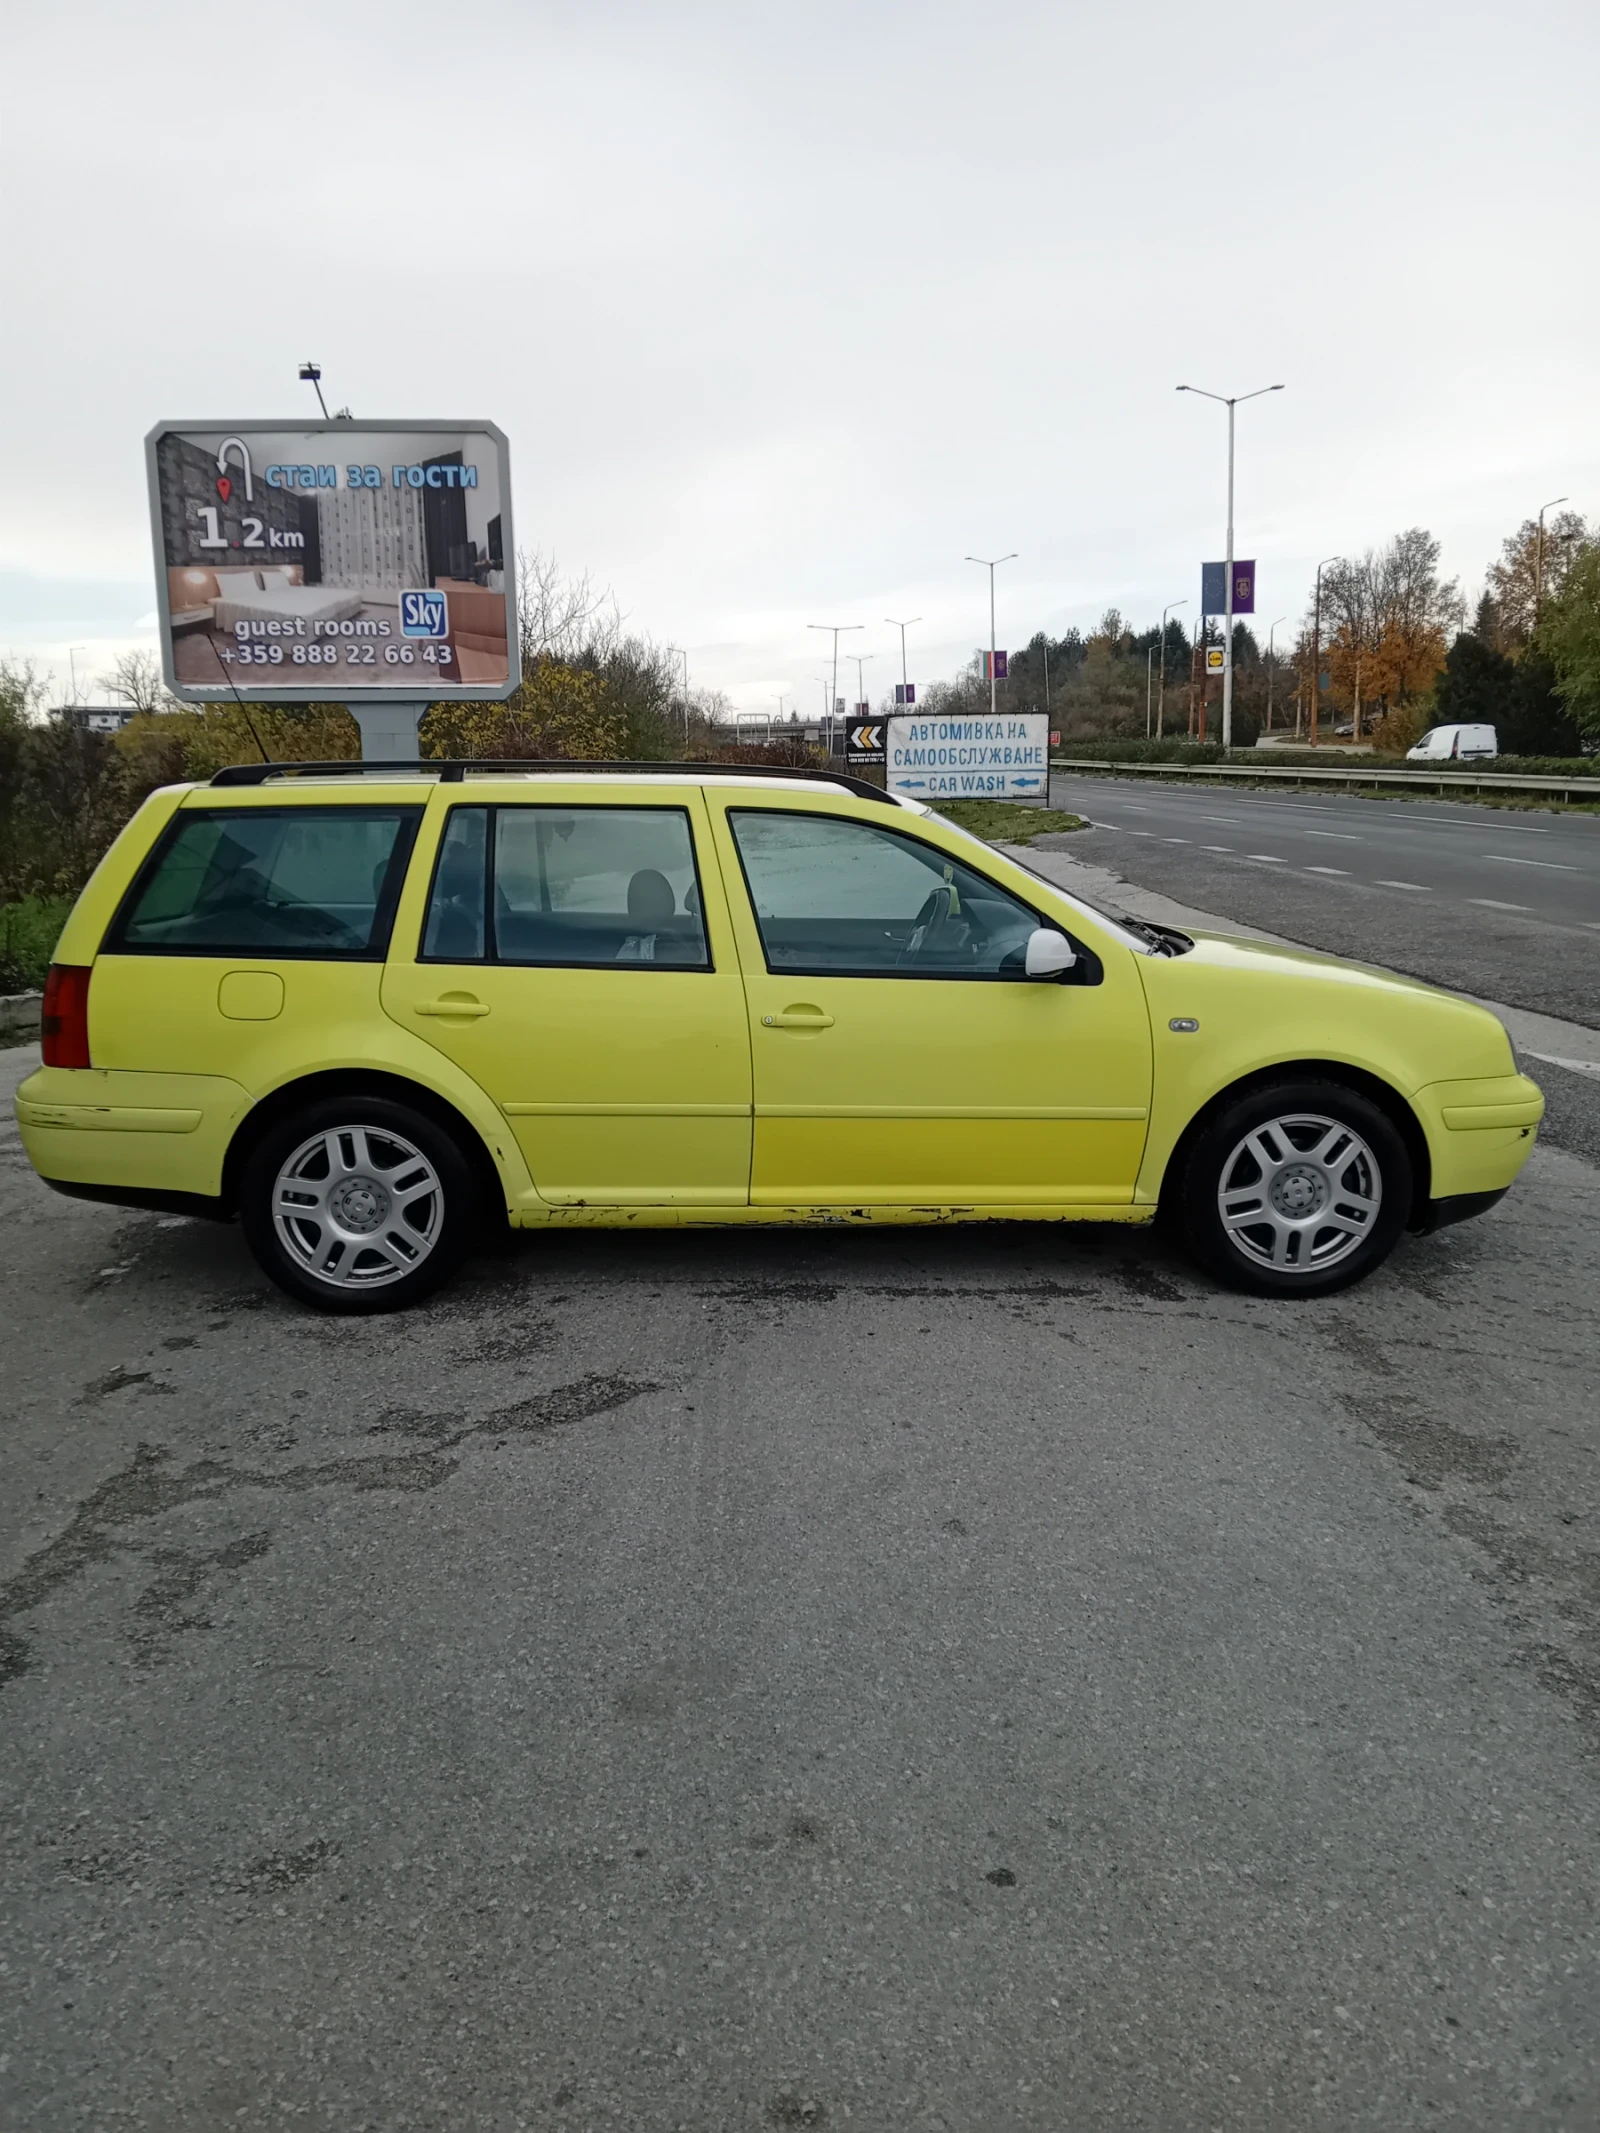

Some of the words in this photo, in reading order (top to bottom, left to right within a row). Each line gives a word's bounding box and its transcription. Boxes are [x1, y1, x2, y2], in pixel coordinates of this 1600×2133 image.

[264, 464, 337, 488] стаи
[347, 464, 381, 488] за
[392, 464, 478, 488] гости
[269, 527, 305, 548] km
[405, 594, 443, 634] Sky
[235, 616, 306, 640] guest
[313, 618, 391, 636] rooms
[220, 645, 283, 664] +359
[292, 645, 338, 664] 888
[346, 645, 376, 664] 22
[384, 645, 414, 664] 66
[422, 645, 452, 664] 43
[909, 721, 1003, 741] АВТОМИВКА
[1007, 722, 1027, 739] НА
[894, 746, 1043, 767] САМООБСЛУЖВАНЕ
[928, 777, 957, 791] CAR
[960, 776, 1005, 791] WASH
